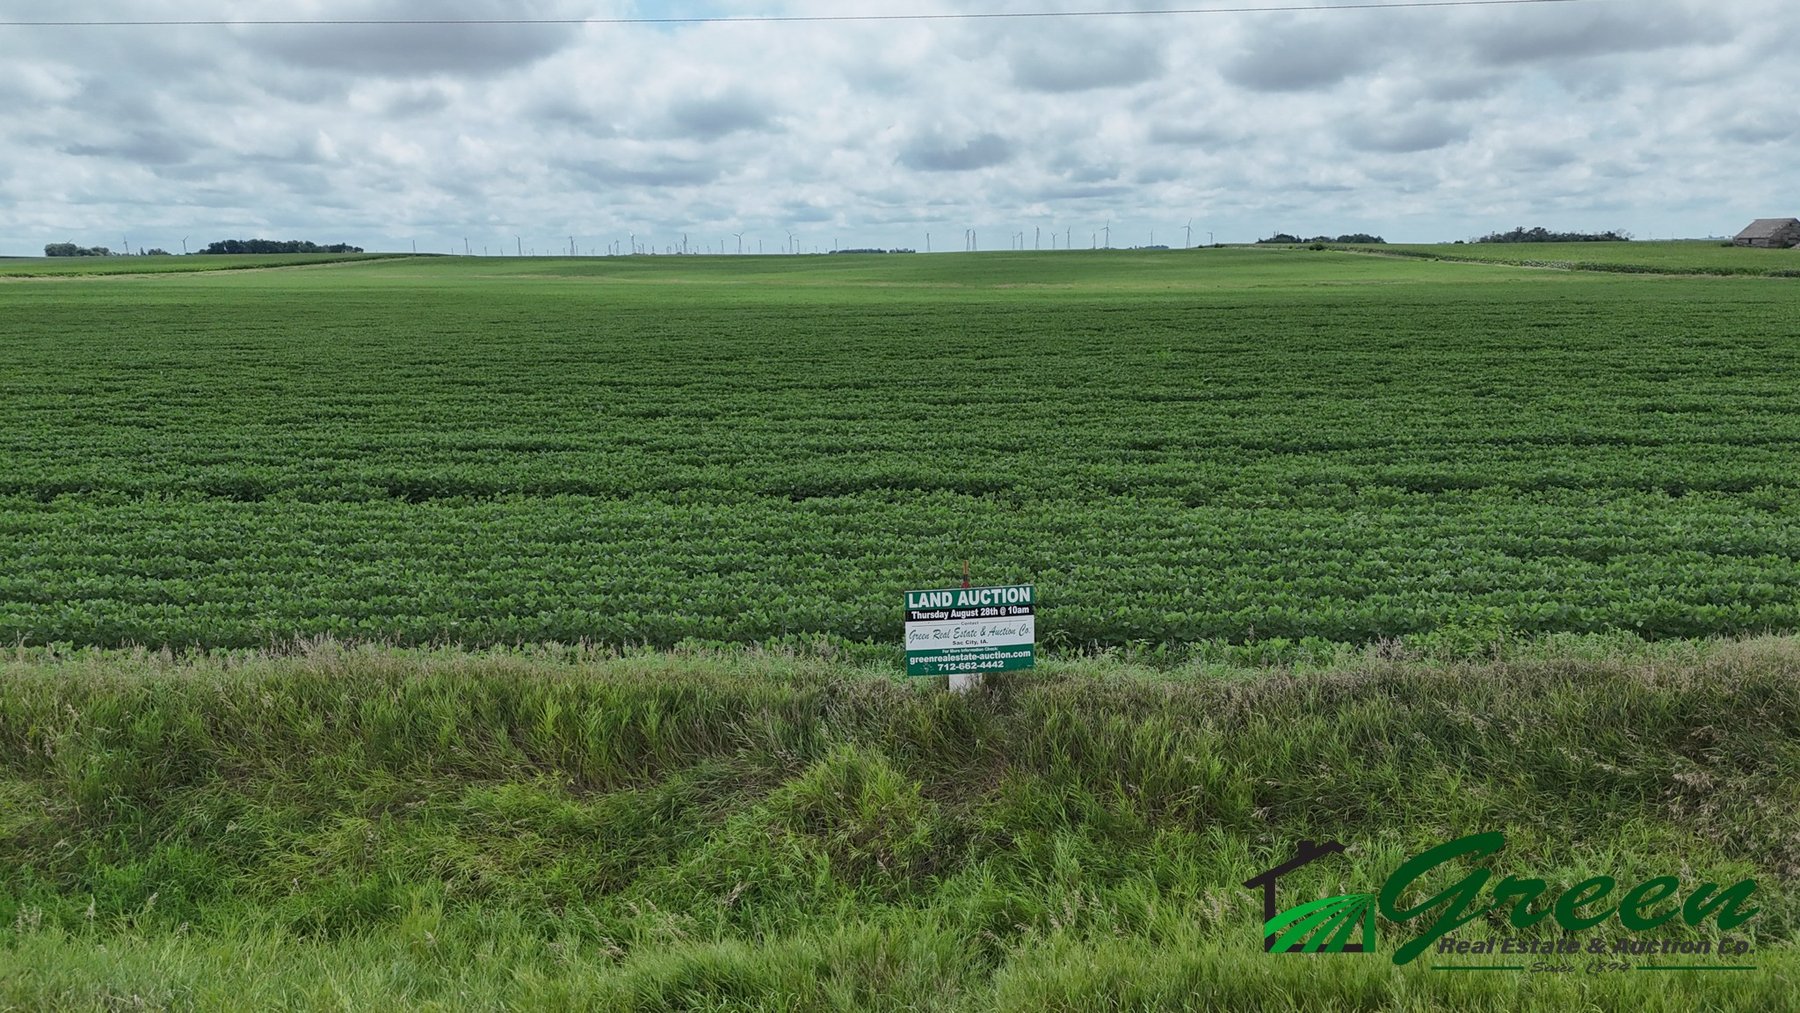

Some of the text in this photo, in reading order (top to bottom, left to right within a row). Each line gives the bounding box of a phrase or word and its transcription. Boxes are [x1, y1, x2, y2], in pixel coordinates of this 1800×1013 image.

[908, 587, 1030, 608] LAND AUCTION
[911, 611, 948, 620] Thursday
[951, 610, 978, 618] August
[1009, 606, 1029, 614] 10am
[909, 630, 929, 644] Green
[933, 629, 950, 639] Real
[954, 627, 977, 639] Estate
[980, 626, 985, 636] &
[988, 626, 1015, 637] Auction
[910, 650, 1030, 665] greenrealestate-auction.com
[938, 661, 1004, 671] 712-662-4442
